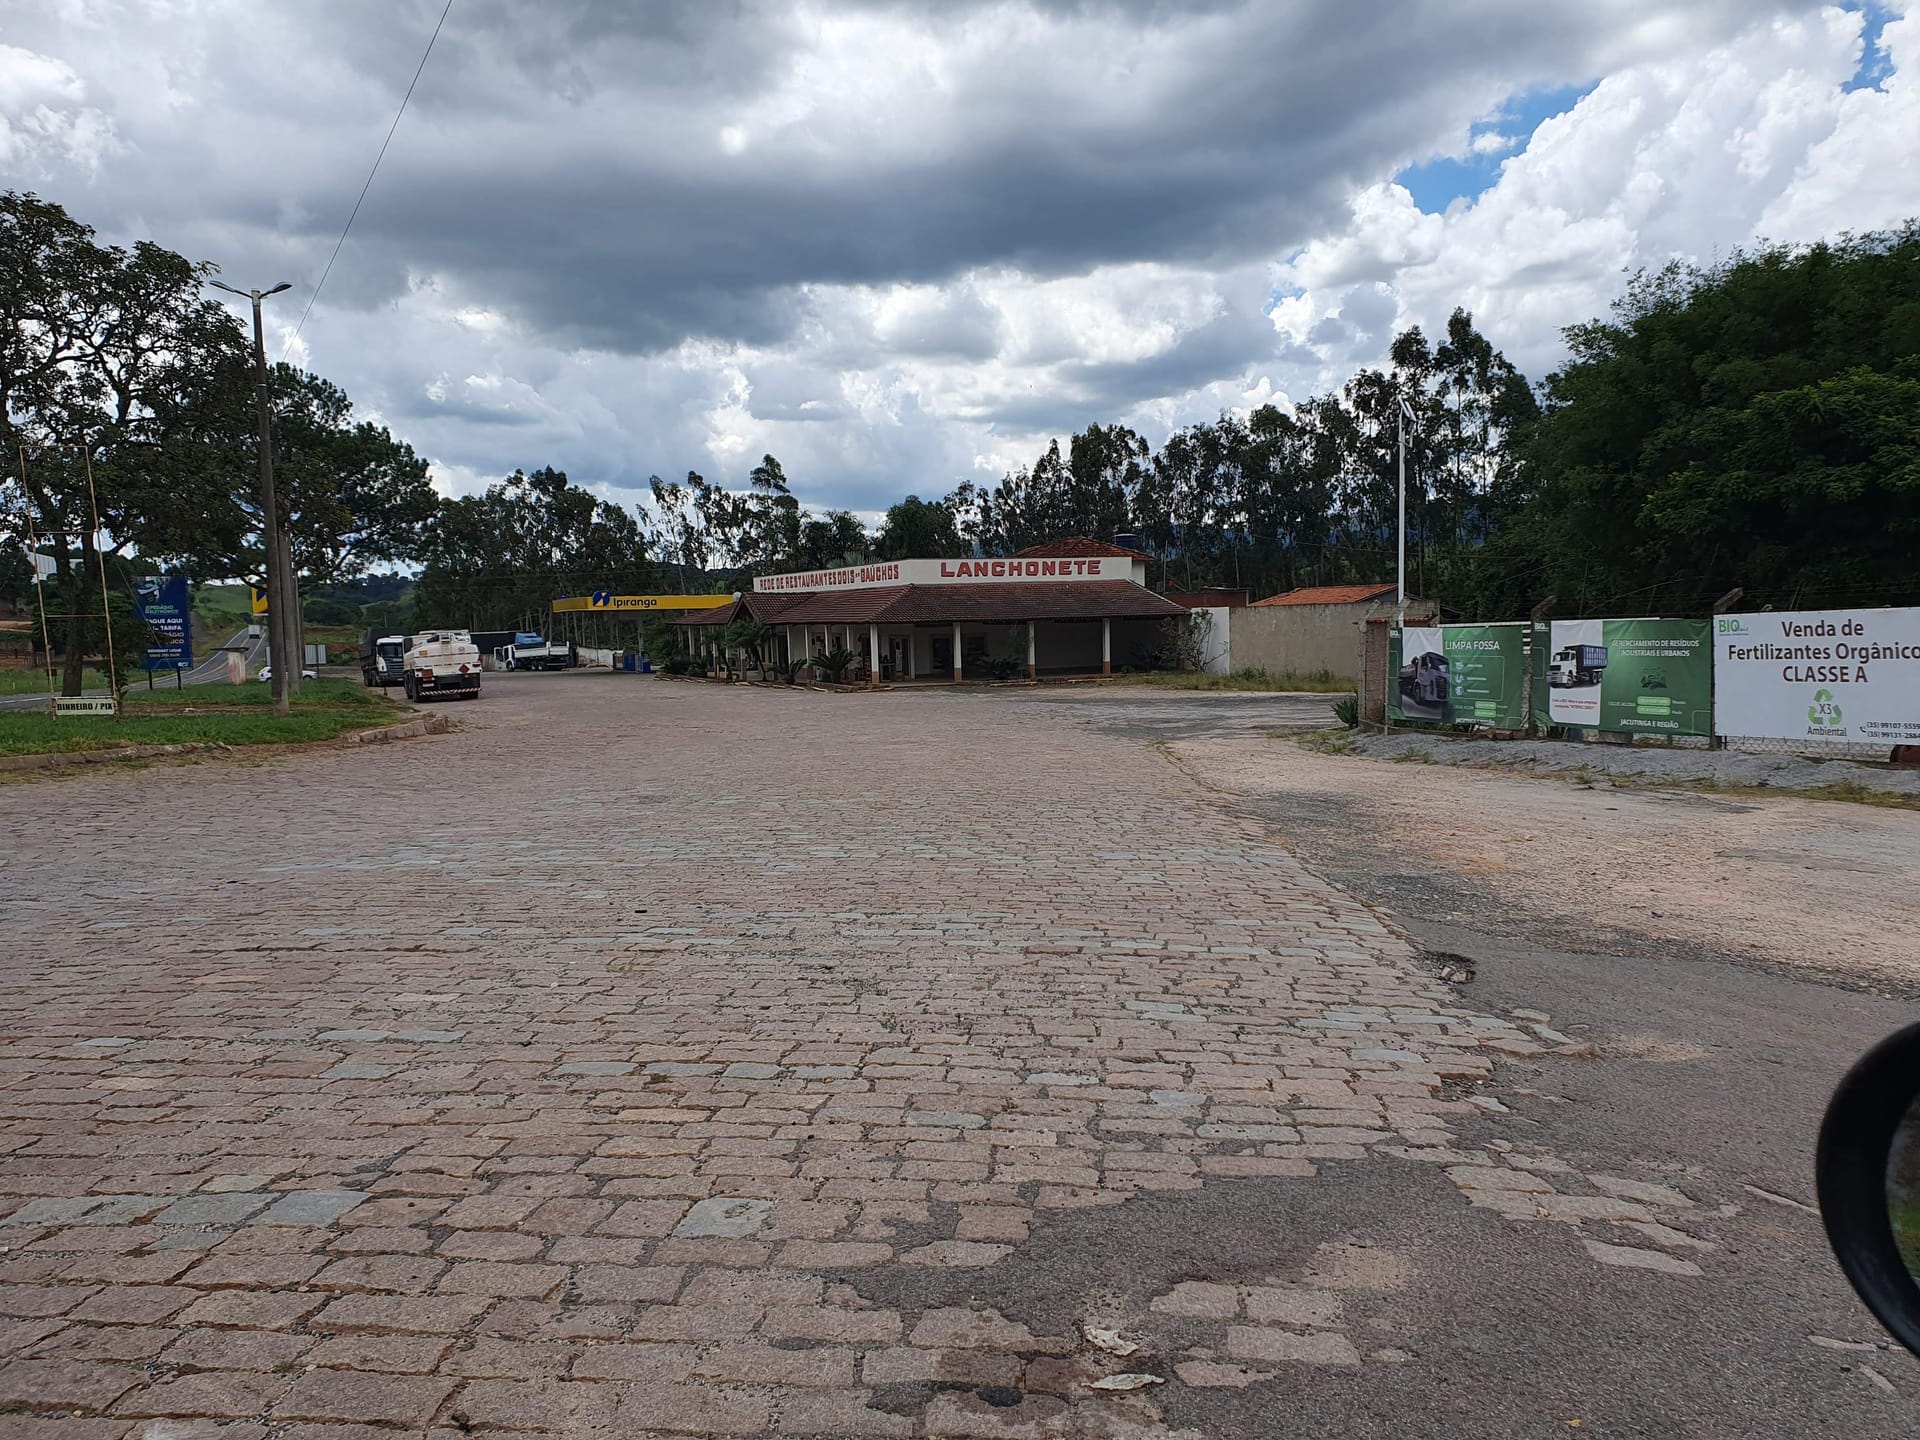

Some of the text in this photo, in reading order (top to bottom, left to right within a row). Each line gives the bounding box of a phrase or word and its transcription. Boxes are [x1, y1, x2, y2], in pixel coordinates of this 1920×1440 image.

[940, 559, 1101, 577] LANCHONETE
[759, 578, 775, 590] REDE
[776, 577, 784, 589] DE
[785, 572, 837, 588] RESTAURANTES
[837, 569, 855, 585] DOIS
[613, 598, 657, 608] Ipiranga
[1782, 619, 1864, 637] Venda de
[1445, 641, 1500, 650] LIMPA FOSSA
[1728, 644, 1830, 660] Fertilizantes
[1783, 666, 1868, 682] CLASSE A
[100, 702, 113, 710] PIX
[1819, 703, 1832, 715] X3
[1807, 726, 1847, 737] Ambiental
